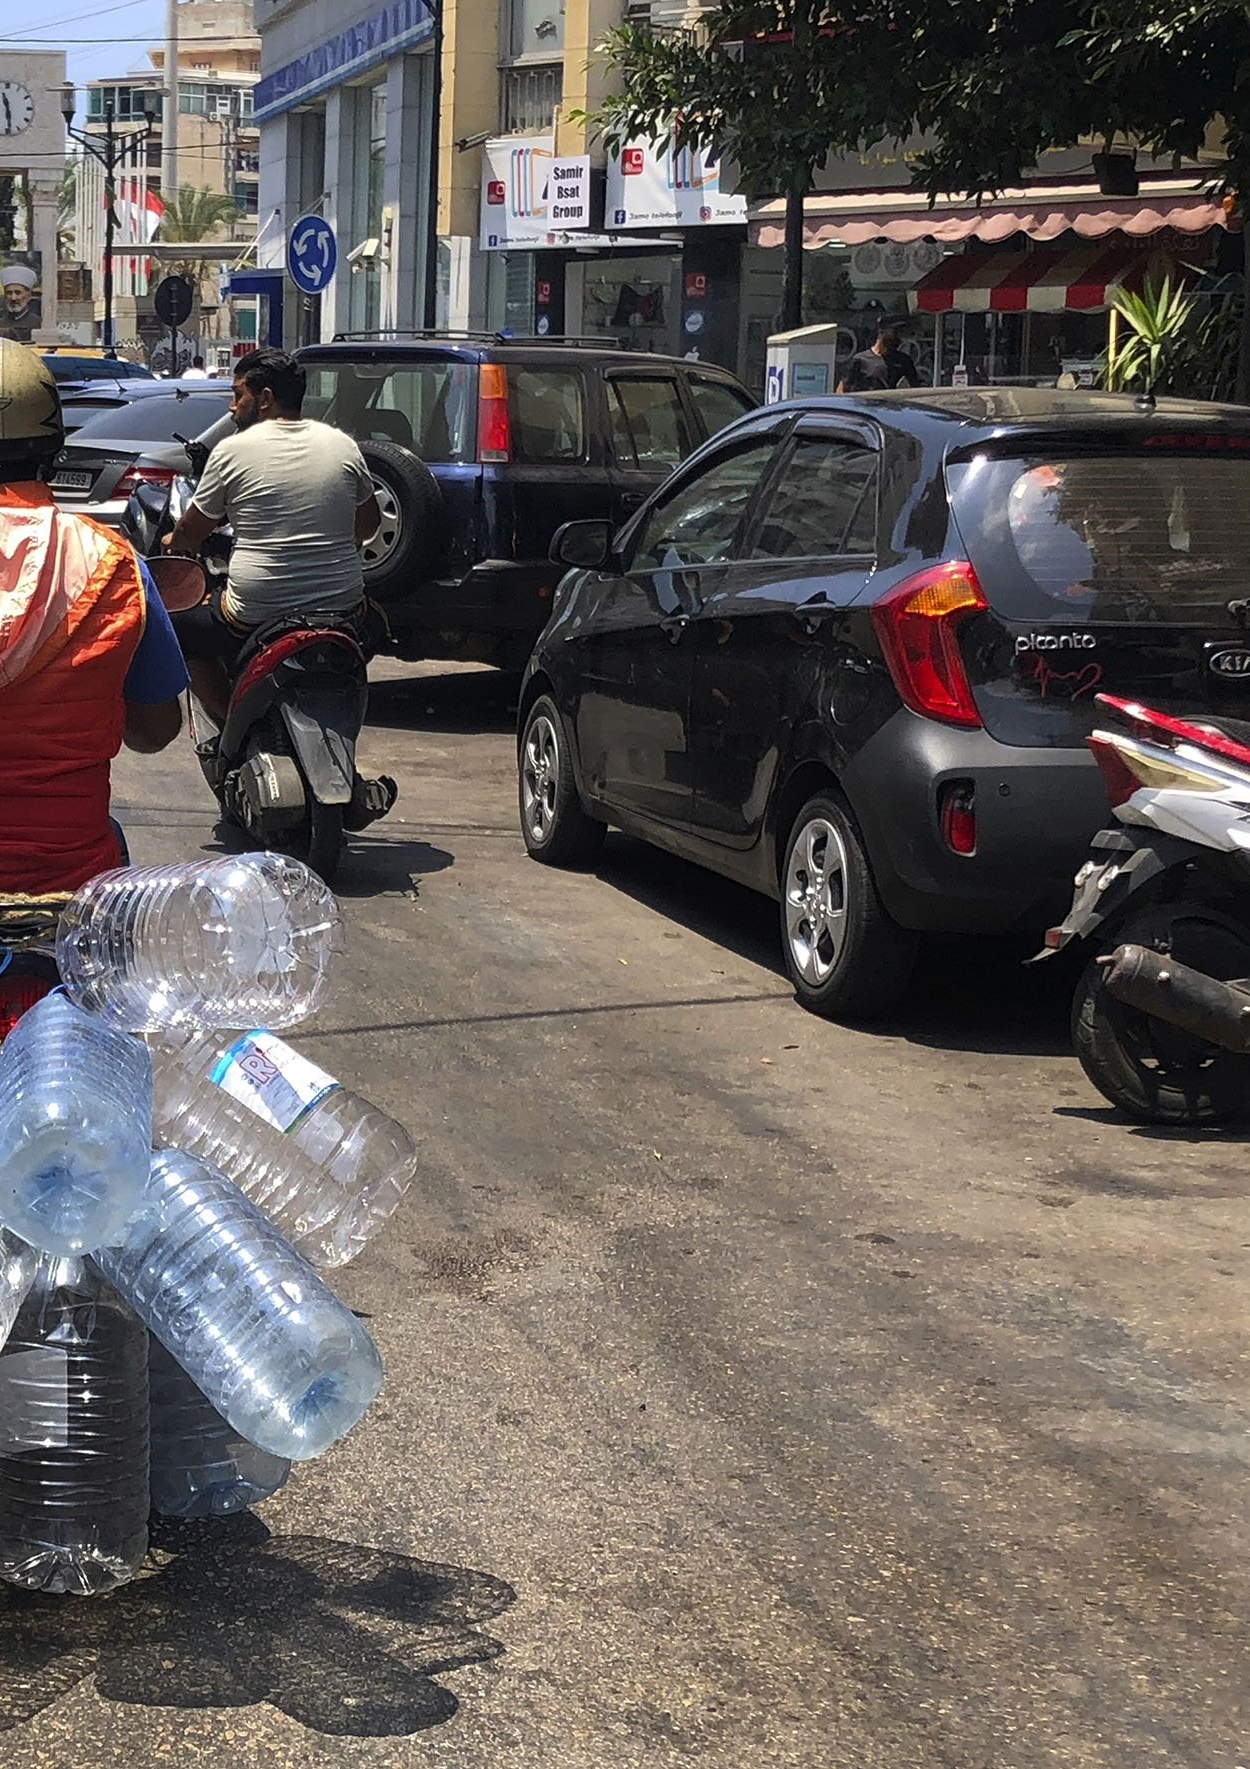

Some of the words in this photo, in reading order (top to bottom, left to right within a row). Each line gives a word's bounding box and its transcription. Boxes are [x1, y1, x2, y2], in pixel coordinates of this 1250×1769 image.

[553, 166, 584, 180] Samir
[557, 185, 580, 199] Bsat
[553, 205, 583, 219] Group
[1015, 632, 1097, 656] picanto
